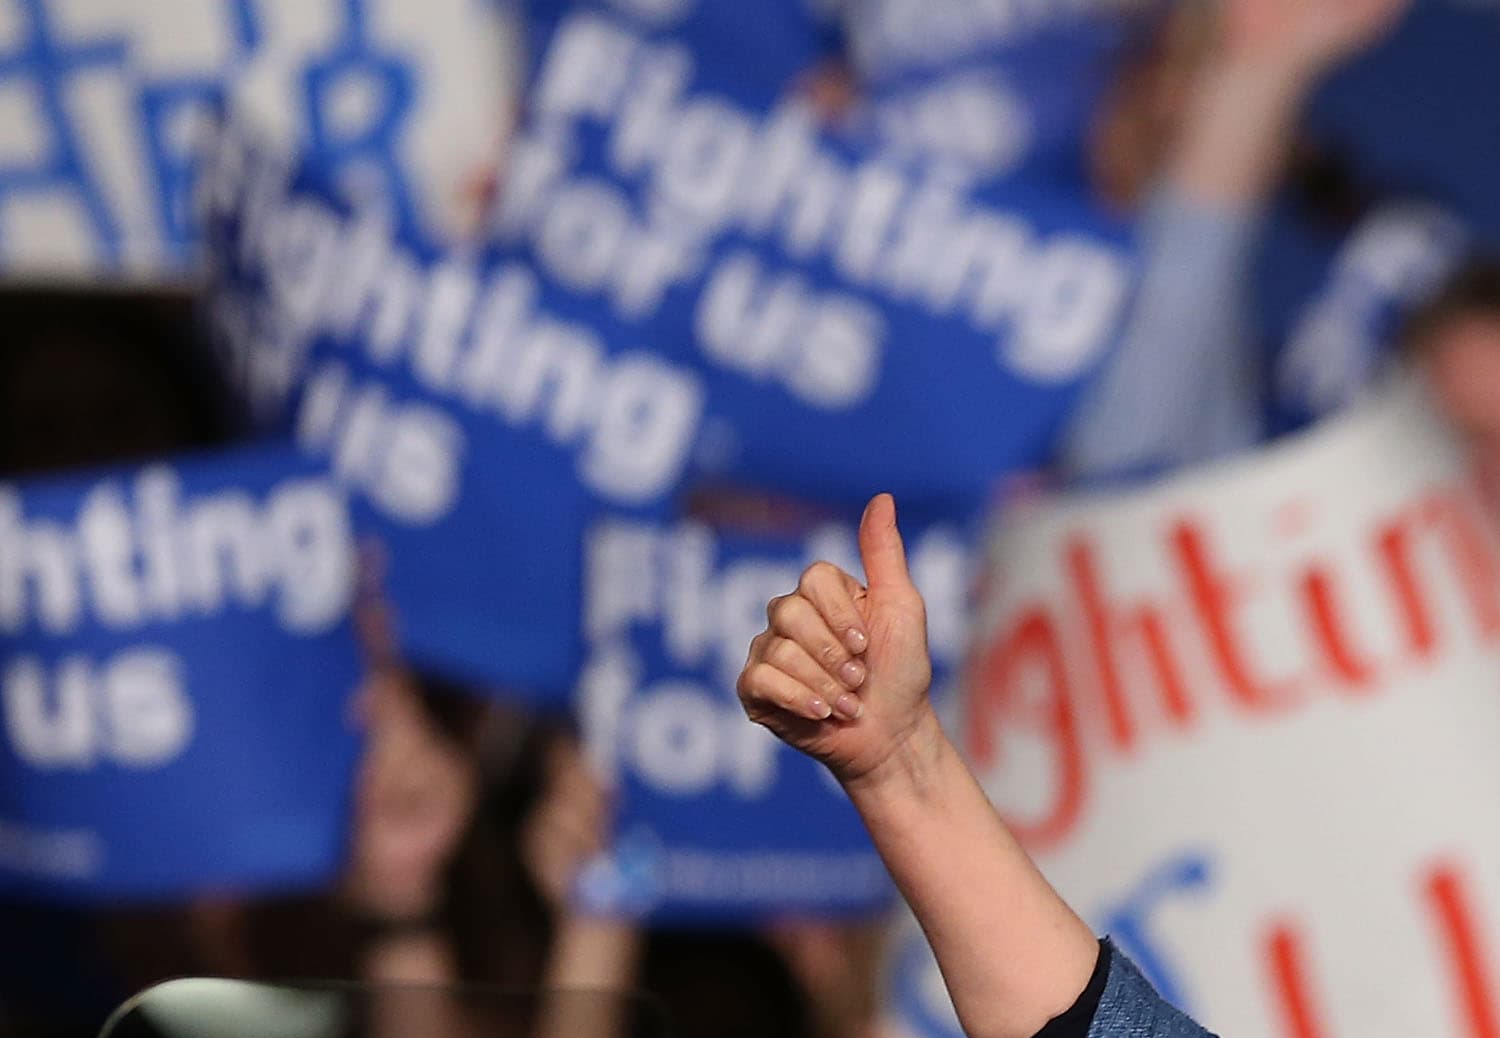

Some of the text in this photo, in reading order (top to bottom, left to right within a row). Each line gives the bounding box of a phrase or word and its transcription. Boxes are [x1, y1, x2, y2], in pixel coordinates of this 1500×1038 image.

[535, 12, 1132, 388] Fighting
[696, 248, 888, 410] us
[3, 643, 195, 772] us
